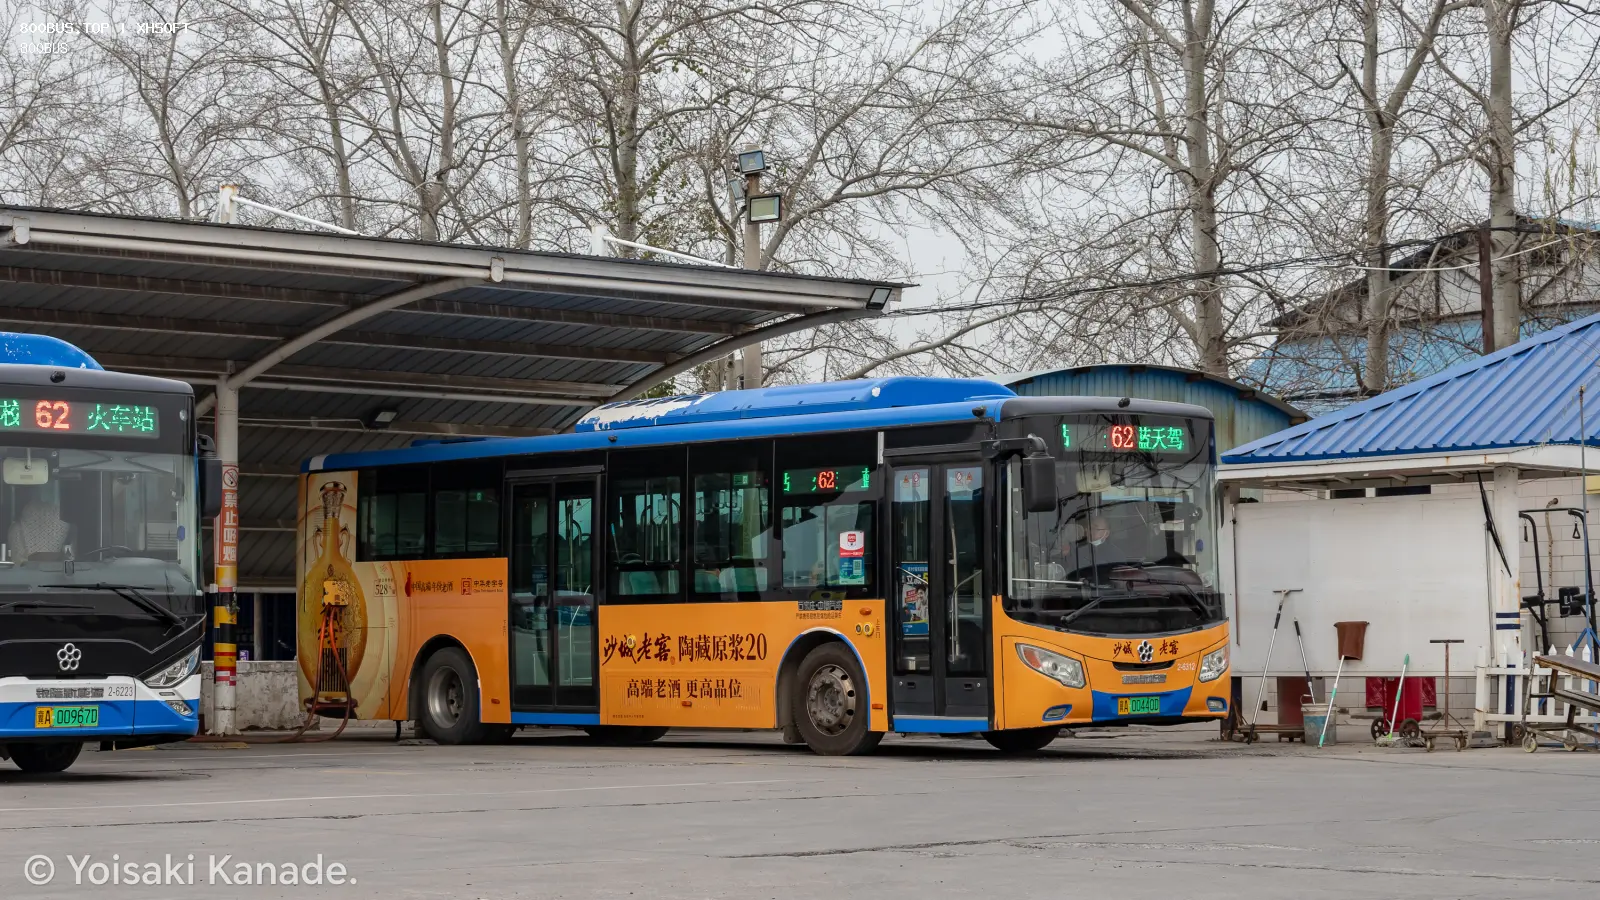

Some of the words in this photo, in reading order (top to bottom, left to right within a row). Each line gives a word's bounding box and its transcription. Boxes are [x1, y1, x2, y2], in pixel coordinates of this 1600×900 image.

[35, 400, 70, 430] 62
[86, 403, 155, 432] 火车站
[1111, 425, 1134, 448] 62
[1138, 426, 1184, 450] 蓝天驾
[818, 471, 835, 489] 62
[222, 492, 238, 562] 禁止吸烟
[374, 584, 389, 595] 528
[602, 632, 672, 666] 沙城老窖
[678, 632, 768, 662] 陶藏原浆20
[1112, 641, 1134, 659] 沙城
[108, 686, 134, 697] 2-6223
[626, 678, 681, 699] 高端老酒
[686, 679, 742, 699] 更高品位
